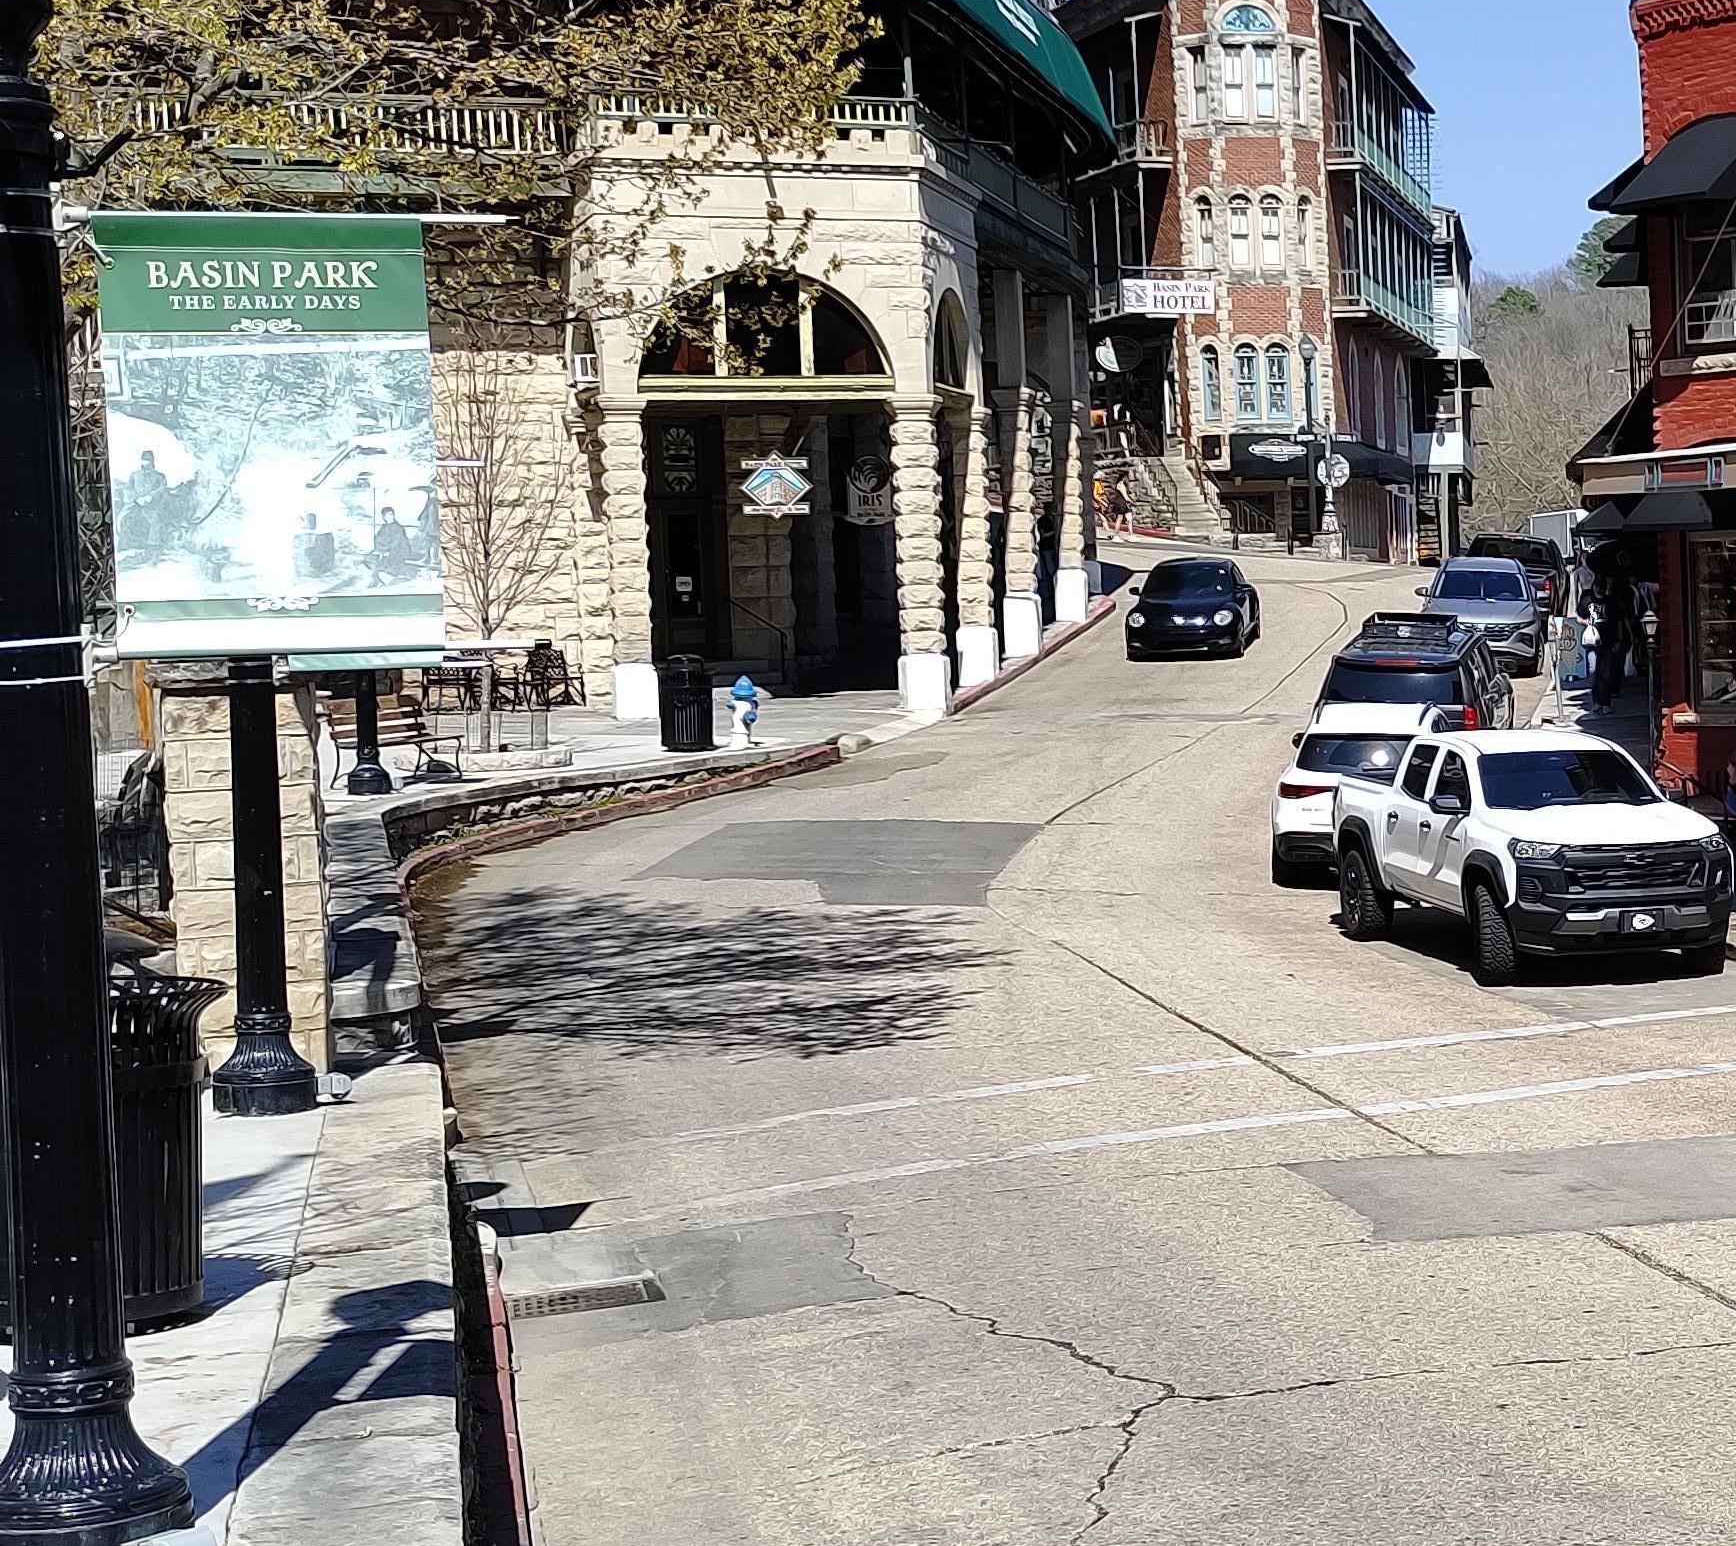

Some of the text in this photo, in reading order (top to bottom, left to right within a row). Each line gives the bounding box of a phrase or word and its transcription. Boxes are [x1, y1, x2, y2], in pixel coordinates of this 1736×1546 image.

[146, 259, 379, 289] BASIN PARK
[1185, 283, 1210, 293] PARK
[169, 295, 361, 310] THE EARLY DAYS
[1154, 295, 1210, 310] HOTEL
[857, 494, 884, 507] IRIS
